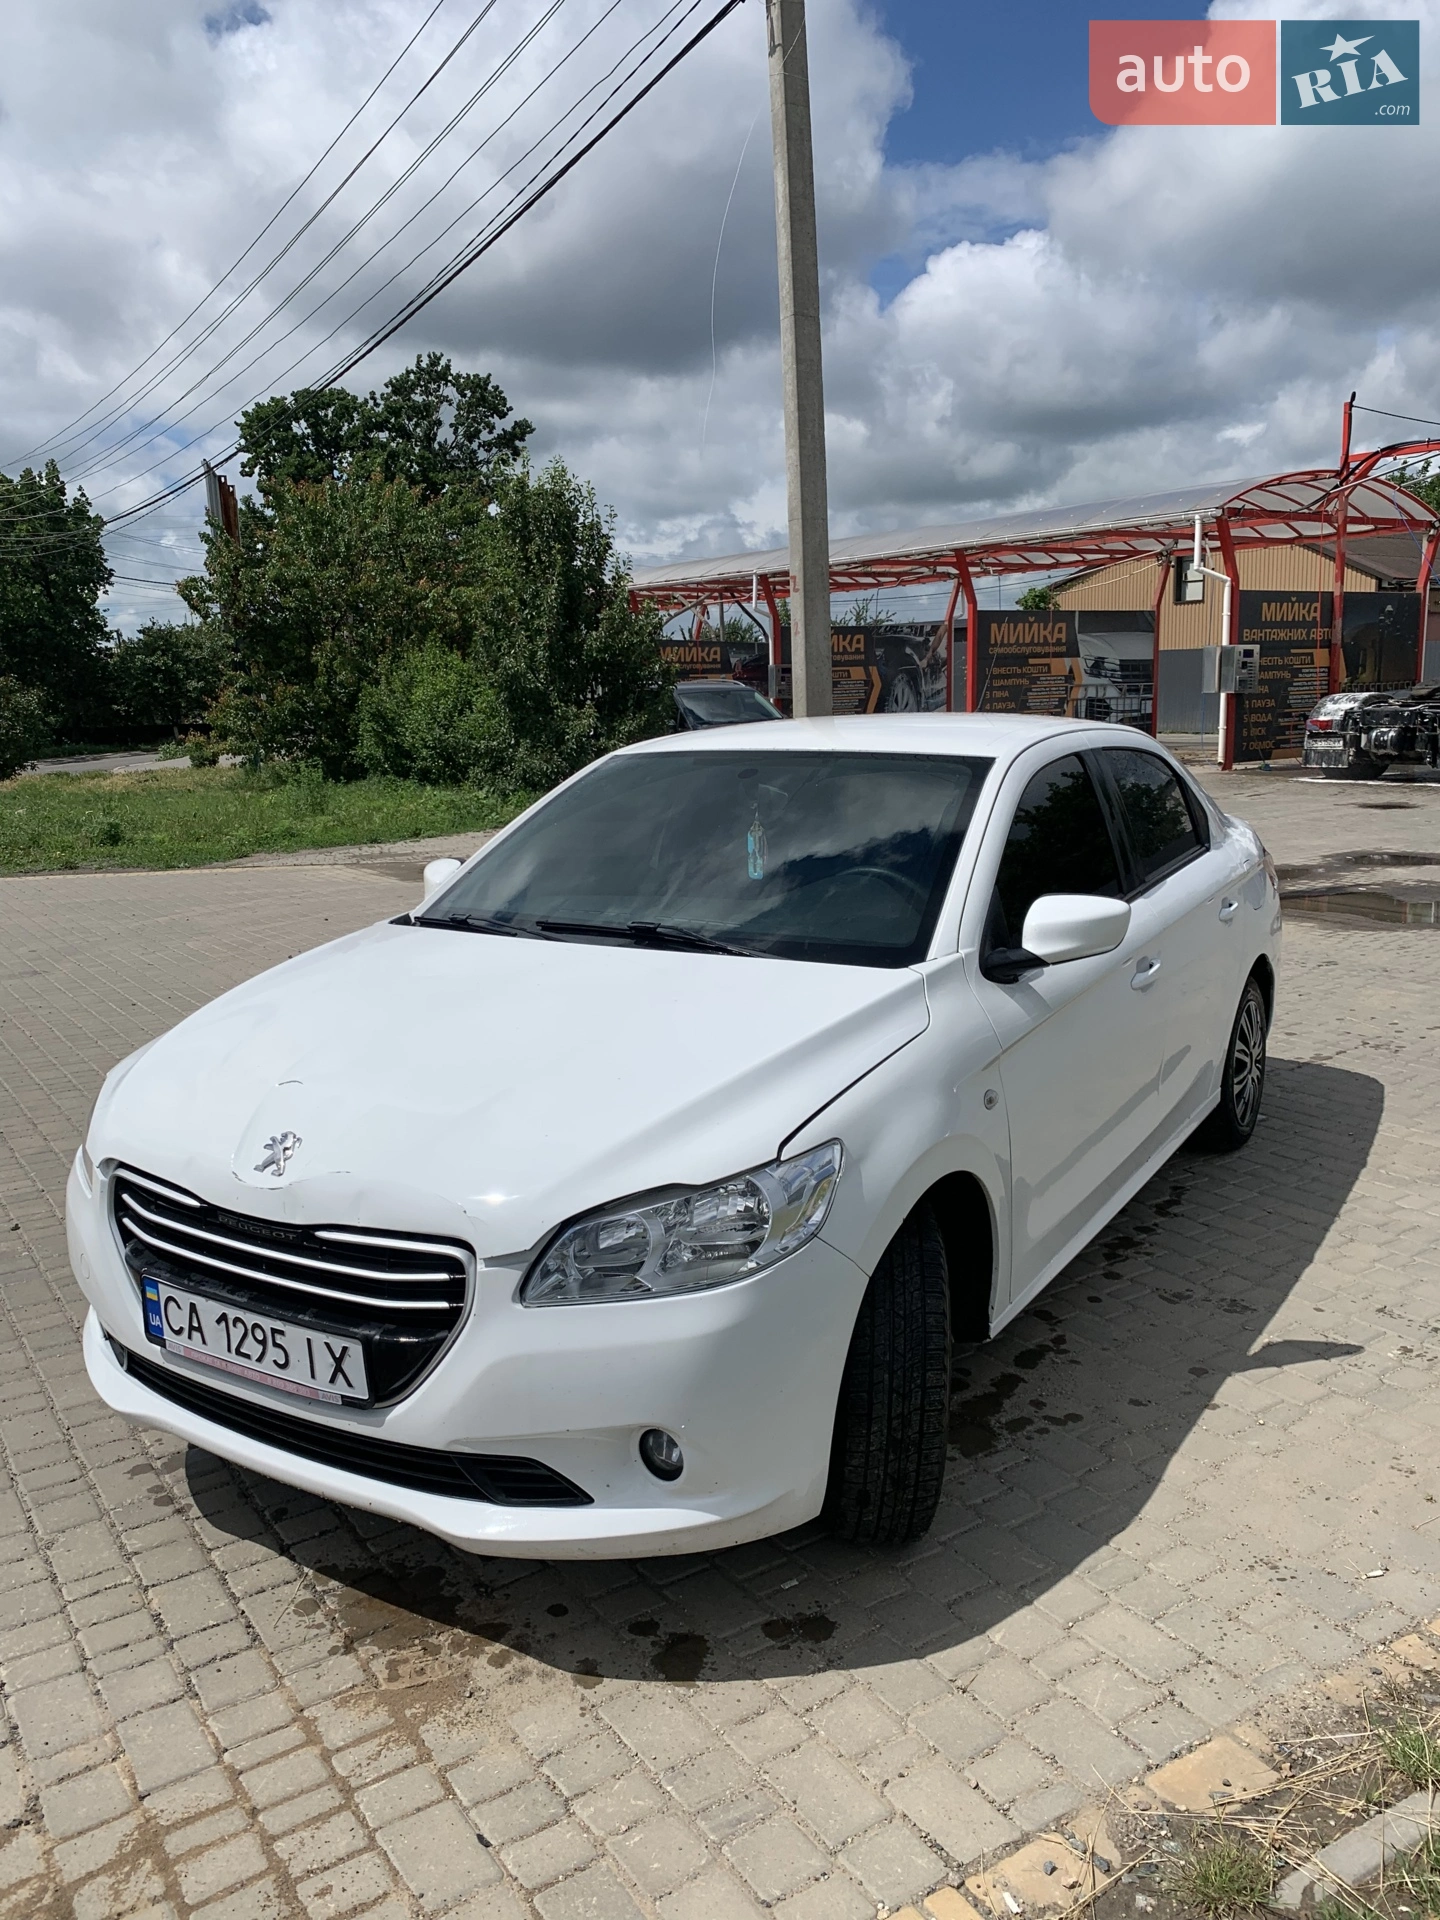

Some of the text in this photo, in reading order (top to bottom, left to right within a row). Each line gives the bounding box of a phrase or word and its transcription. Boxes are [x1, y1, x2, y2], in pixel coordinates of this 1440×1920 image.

[1261, 596, 1320, 622] МИЙКА
[990, 616, 1067, 644] МИЙКА
[1243, 628, 1307, 641] ВАНТАЖНИХ
[988, 644, 1067, 655] самообслуговування
[1284, 655, 1311, 664] КОШТИ
[1022, 665, 1048, 674] КОШТИ
[992, 678, 1030, 687] ШАМПУНЬ
[985, 690, 1009, 699] 3 ПІНА
[992, 702, 1016, 710] ПАУЗА
[1251, 699, 1276, 708] ПАУЗА
[1243, 714, 1248, 722] 5
[1250, 713, 1273, 722] ВОДА
[1242, 728, 1247, 737] 6
[1242, 742, 1247, 750] 7
[218, 1214, 297, 1240] PEUGEOT
[149, 1312, 163, 1328] UA
[163, 1295, 354, 1389] CA 1295 IX
[321, 1391, 340, 1404] AVIS
